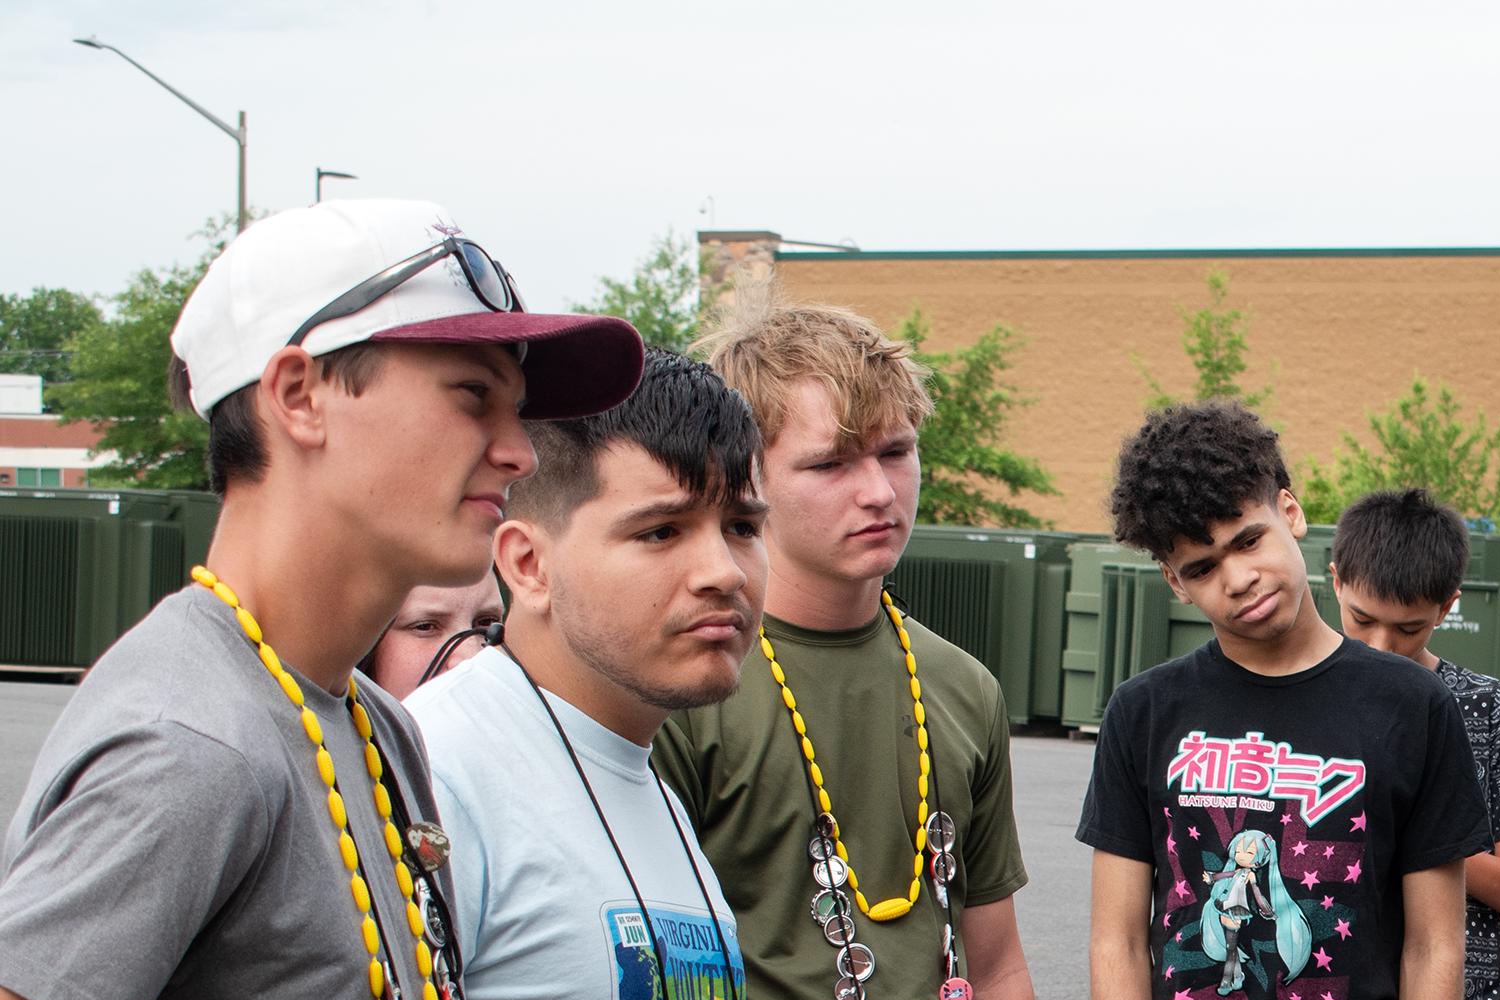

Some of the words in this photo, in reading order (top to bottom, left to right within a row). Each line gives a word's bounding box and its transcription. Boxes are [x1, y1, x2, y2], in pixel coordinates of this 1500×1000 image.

[1168, 731, 1366, 827] 初音ミク
[1178, 794, 1238, 809] HATSUNE
[1238, 797, 1275, 813] MIKU
[624, 925, 647, 944] JUN
